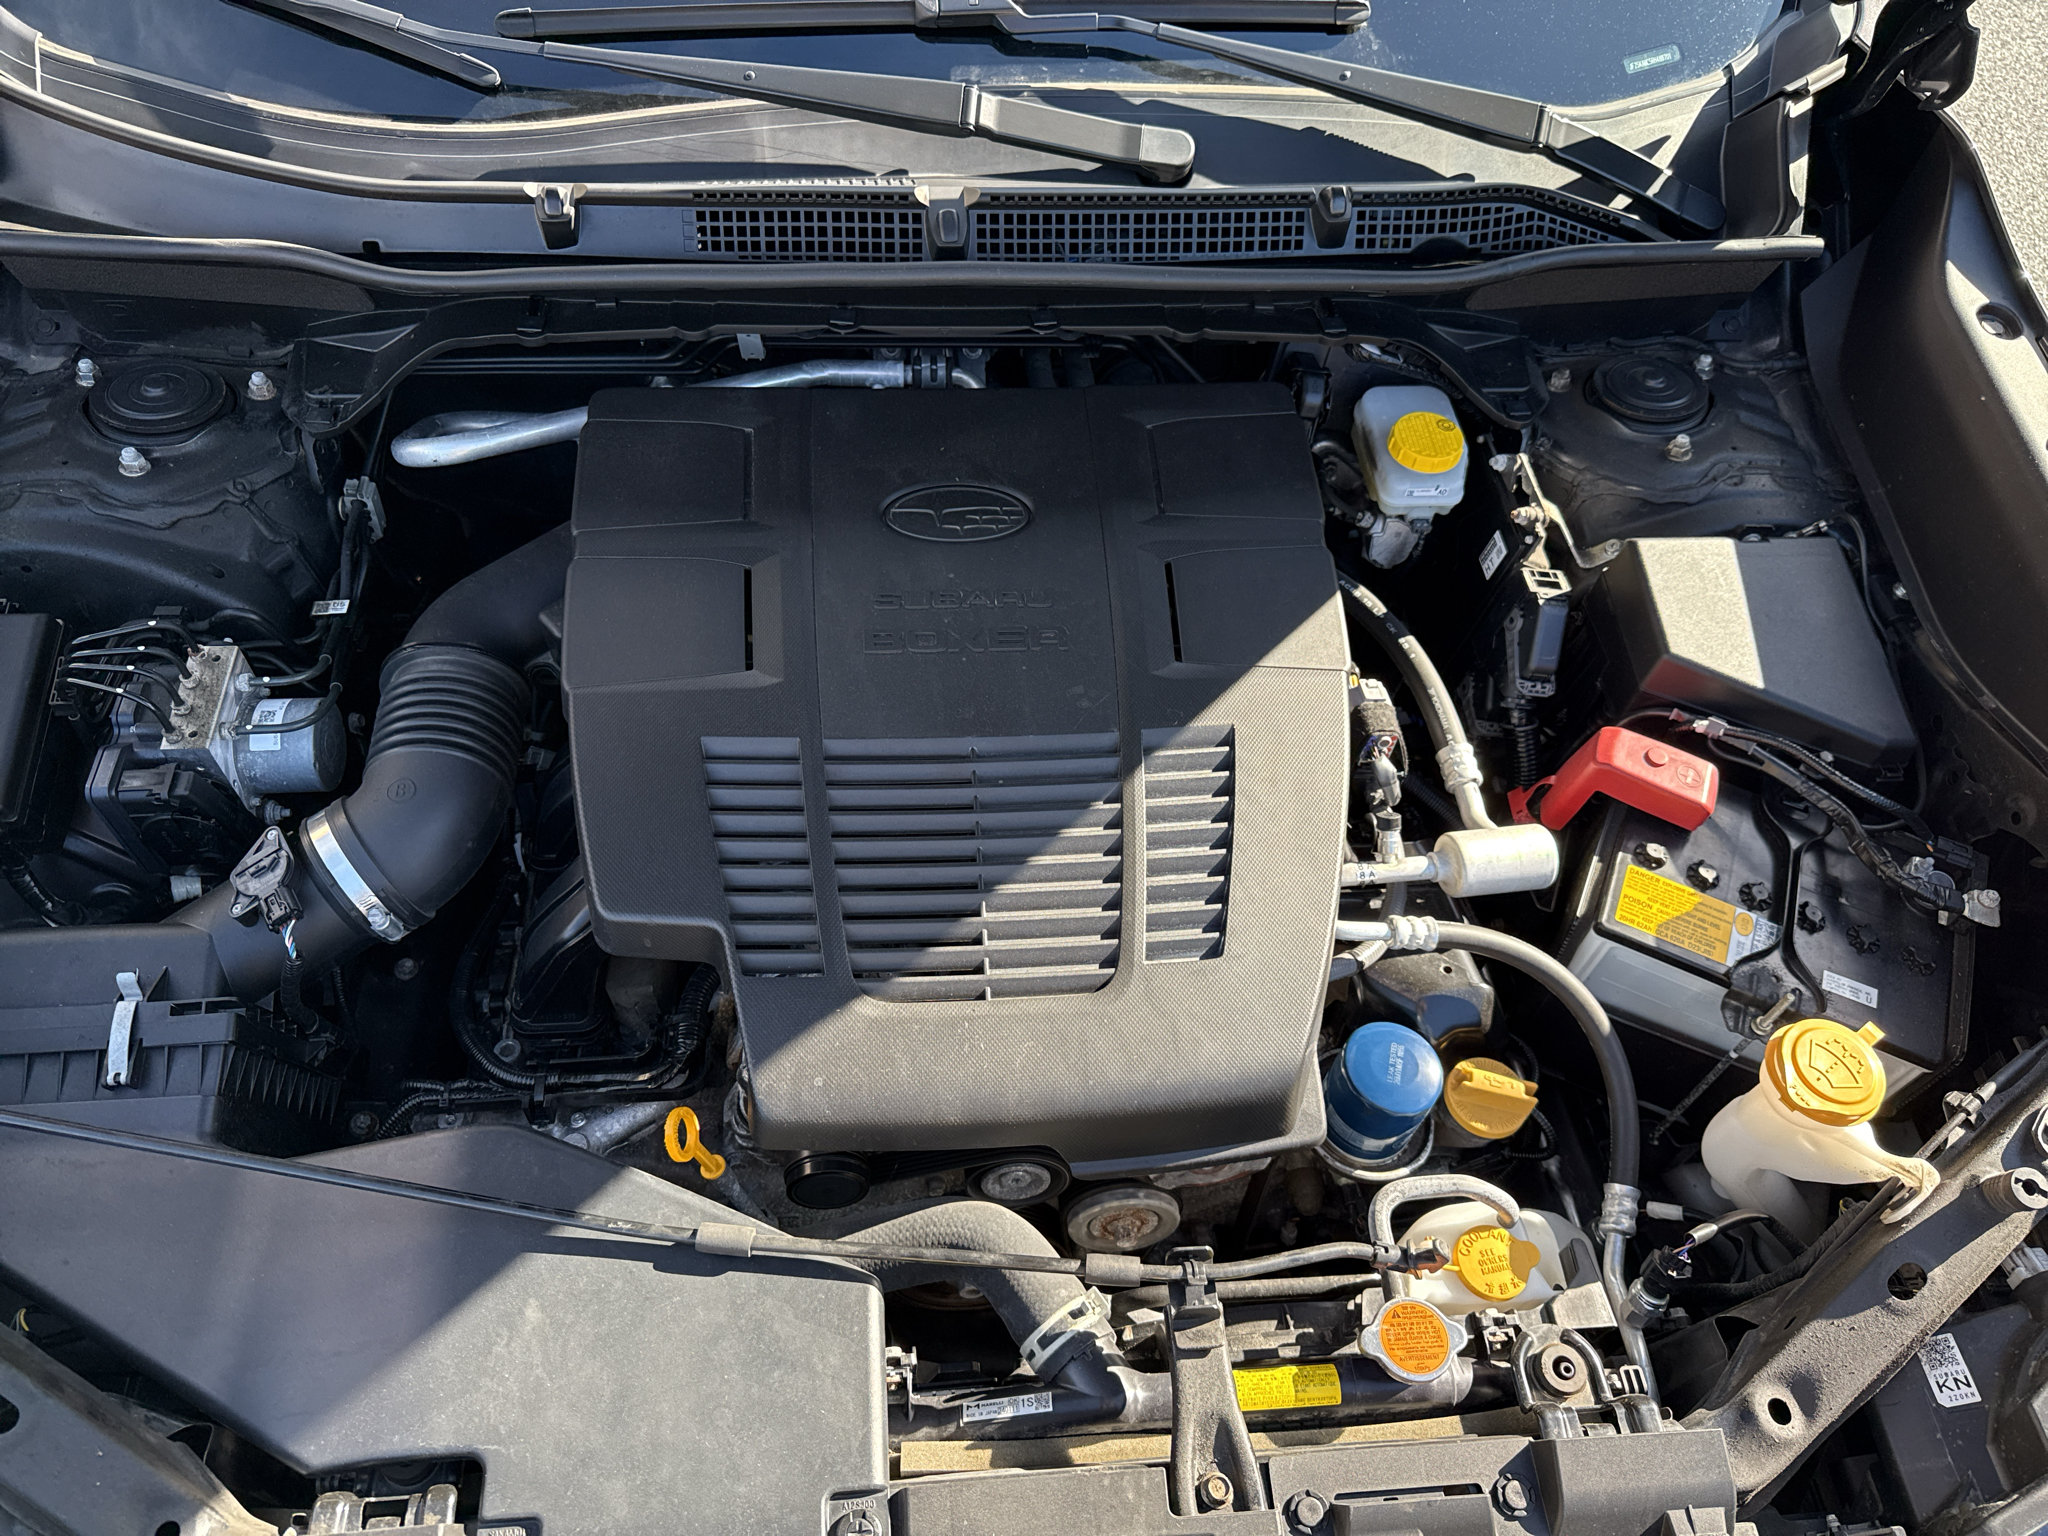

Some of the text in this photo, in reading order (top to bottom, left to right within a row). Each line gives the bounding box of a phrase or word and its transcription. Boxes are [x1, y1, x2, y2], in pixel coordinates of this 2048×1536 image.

[872, 591, 1053, 610] SUBARU
[863, 625, 1070, 654] BOXER
[1629, 867, 1661, 884] DANGER
[1622, 893, 1653, 911] POISON
[1389, 1042, 1398, 1065] TESTED
[1459, 1230, 1514, 1257] COOLANT
[1479, 1248, 1495, 1258] SEE
[1399, 1354, 1440, 1362] AVERTISSEMENT
[1933, 1369, 1966, 1380] SUBARU
[1935, 1375, 1972, 1393] KN
